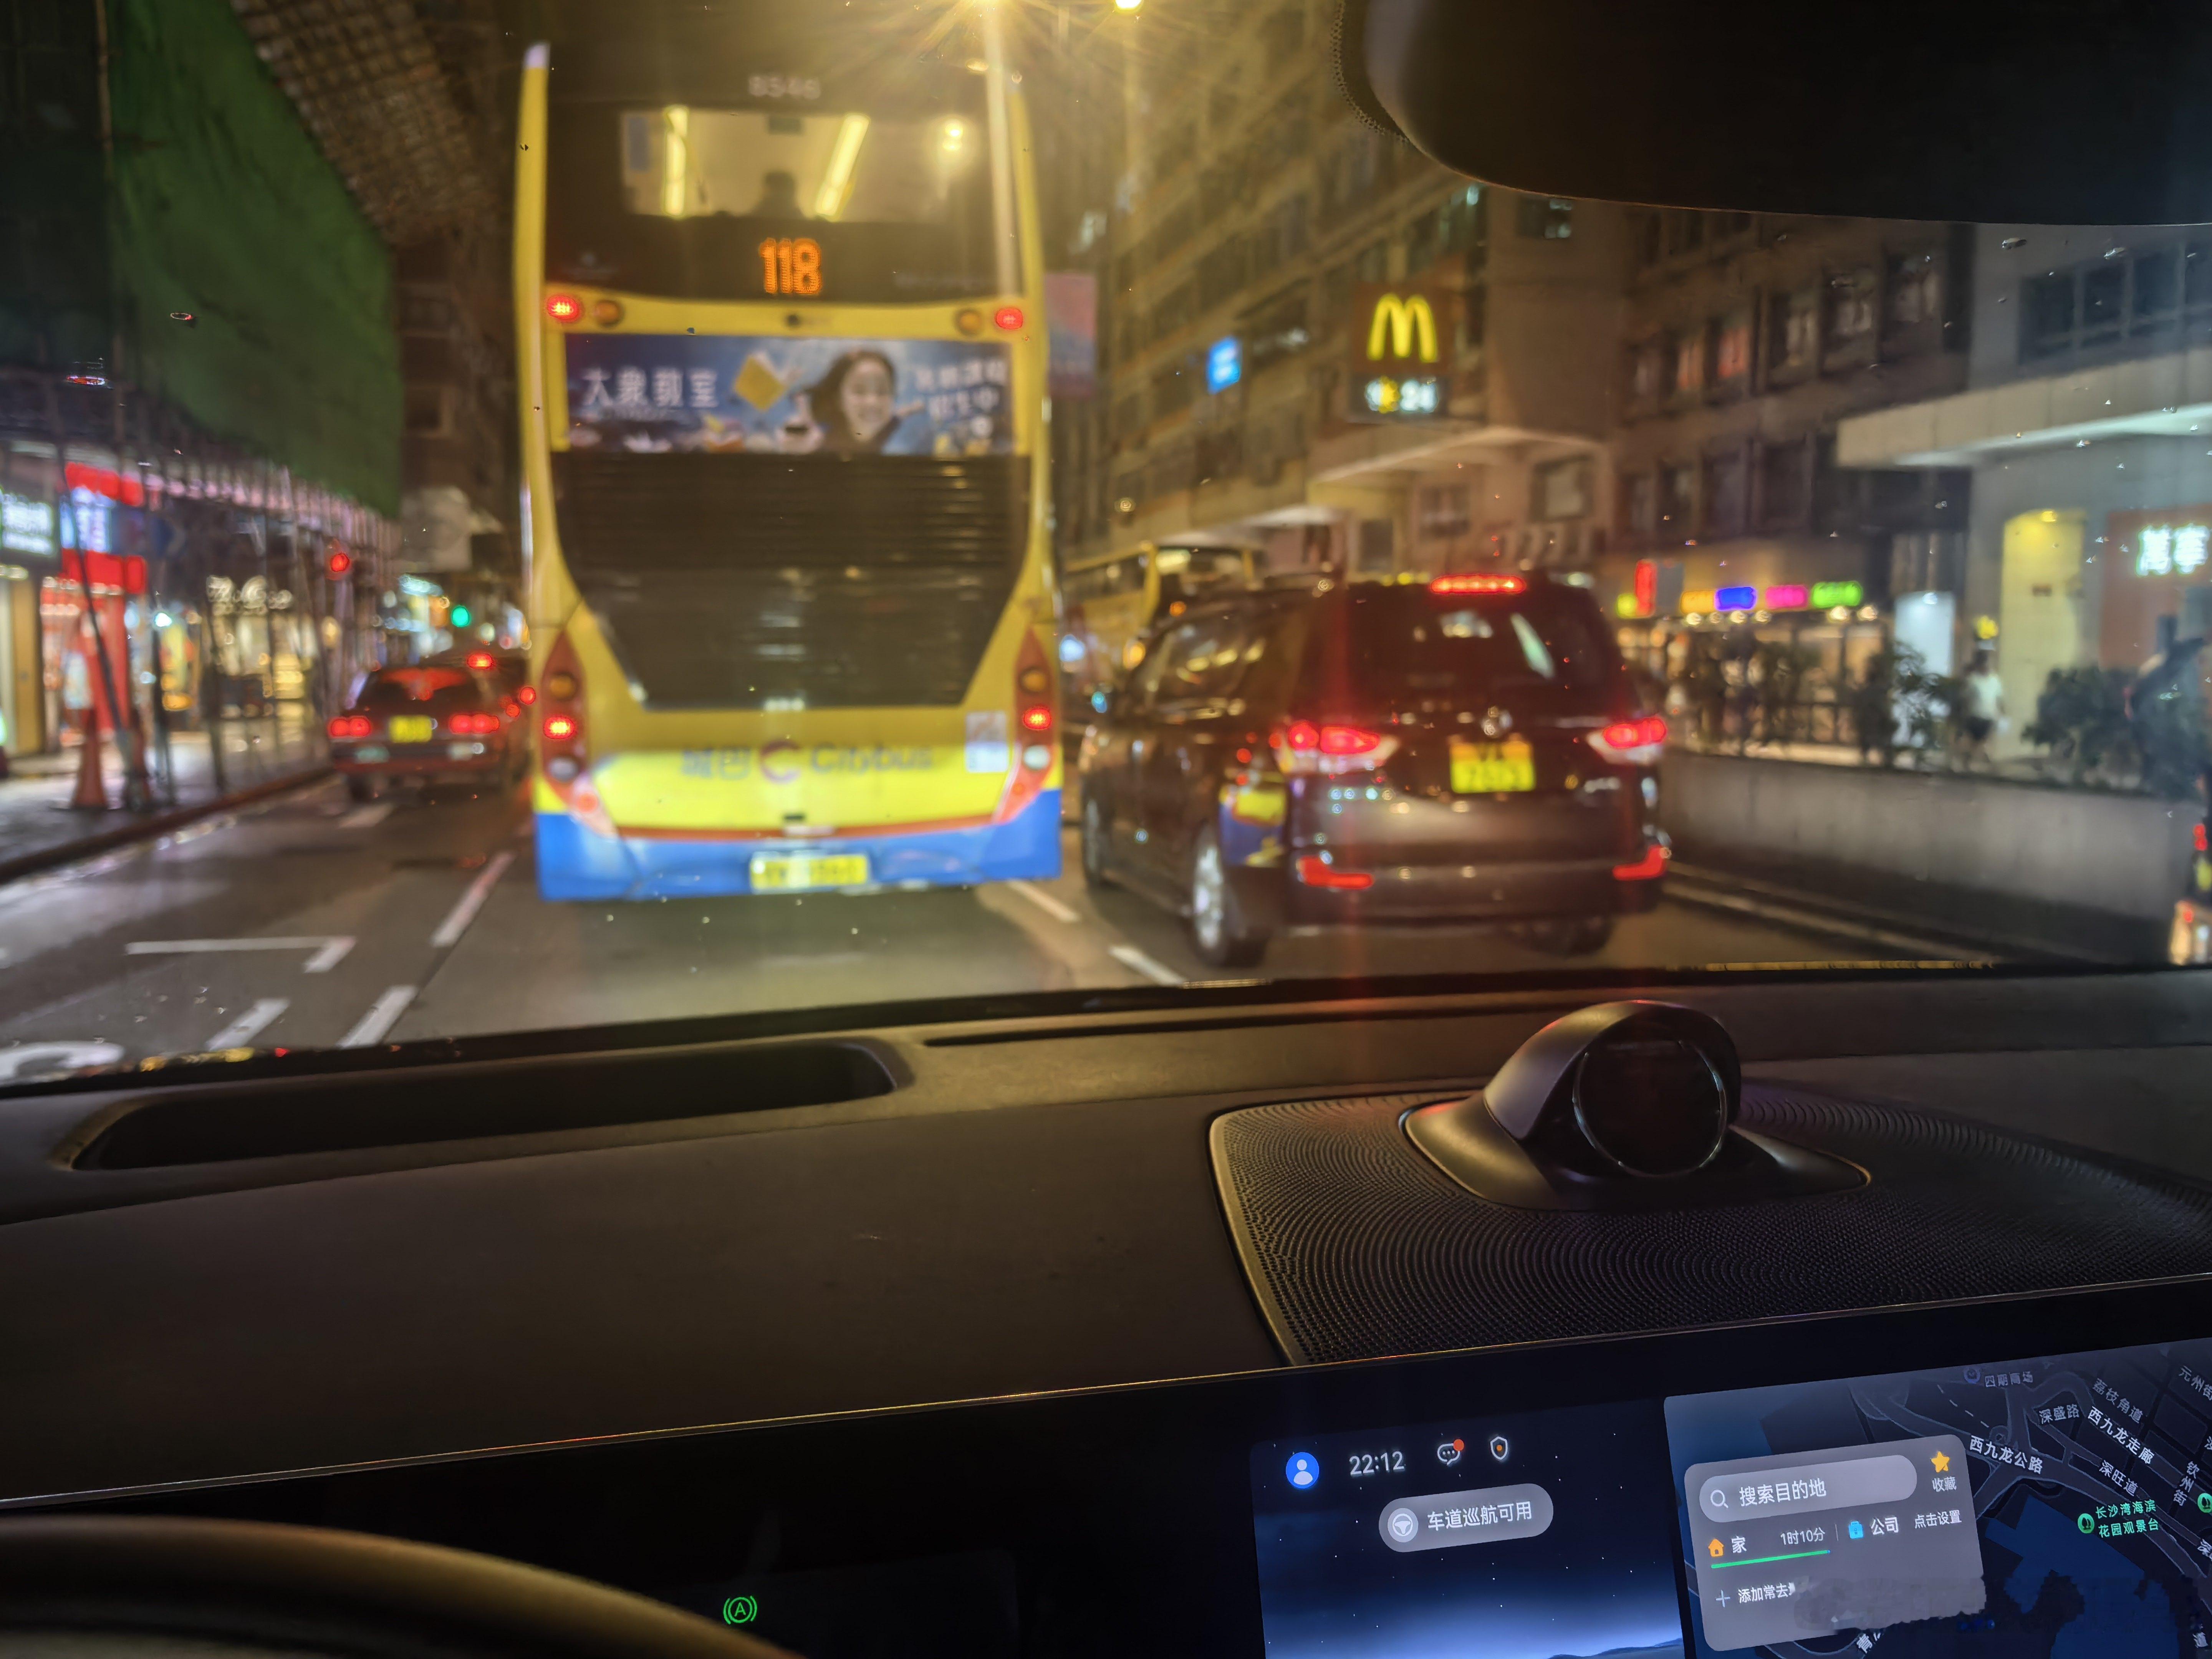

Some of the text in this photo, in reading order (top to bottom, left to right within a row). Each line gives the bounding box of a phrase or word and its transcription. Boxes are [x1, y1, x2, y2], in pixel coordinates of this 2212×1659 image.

[758, 237, 822, 294] 118
[810, 742, 933, 777] Citybus
[2093, 1378, 2143, 1424] 荔枝角道
[2039, 1404, 2080, 1424] 深盛路
[2088, 1406, 2154, 1464] 西九龙走廊
[1349, 1451, 1405, 1475] 22:12
[1970, 1435, 2043, 1474] 西九龙公路
[1932, 1476, 1957, 1493] 收藏
[2099, 1460, 2138, 1497] 深旺道
[2174, 1461, 2200, 1506] 钦州街
[1739, 1478, 1827, 1507] 搜索目的地
[1427, 1501, 1532, 1531] 车道巡航可用
[1914, 1510, 1962, 1529] 点击设置
[2096, 1499, 2156, 1519] 长沙湾海滨
[1780, 1527, 1825, 1546] 1时10分
[1870, 1517, 1900, 1536] 公司
[2098, 1518, 2159, 1538] 花园观景台
[1731, 1536, 1747, 1553] 家
[1856, 1633, 1881, 1654] 青
